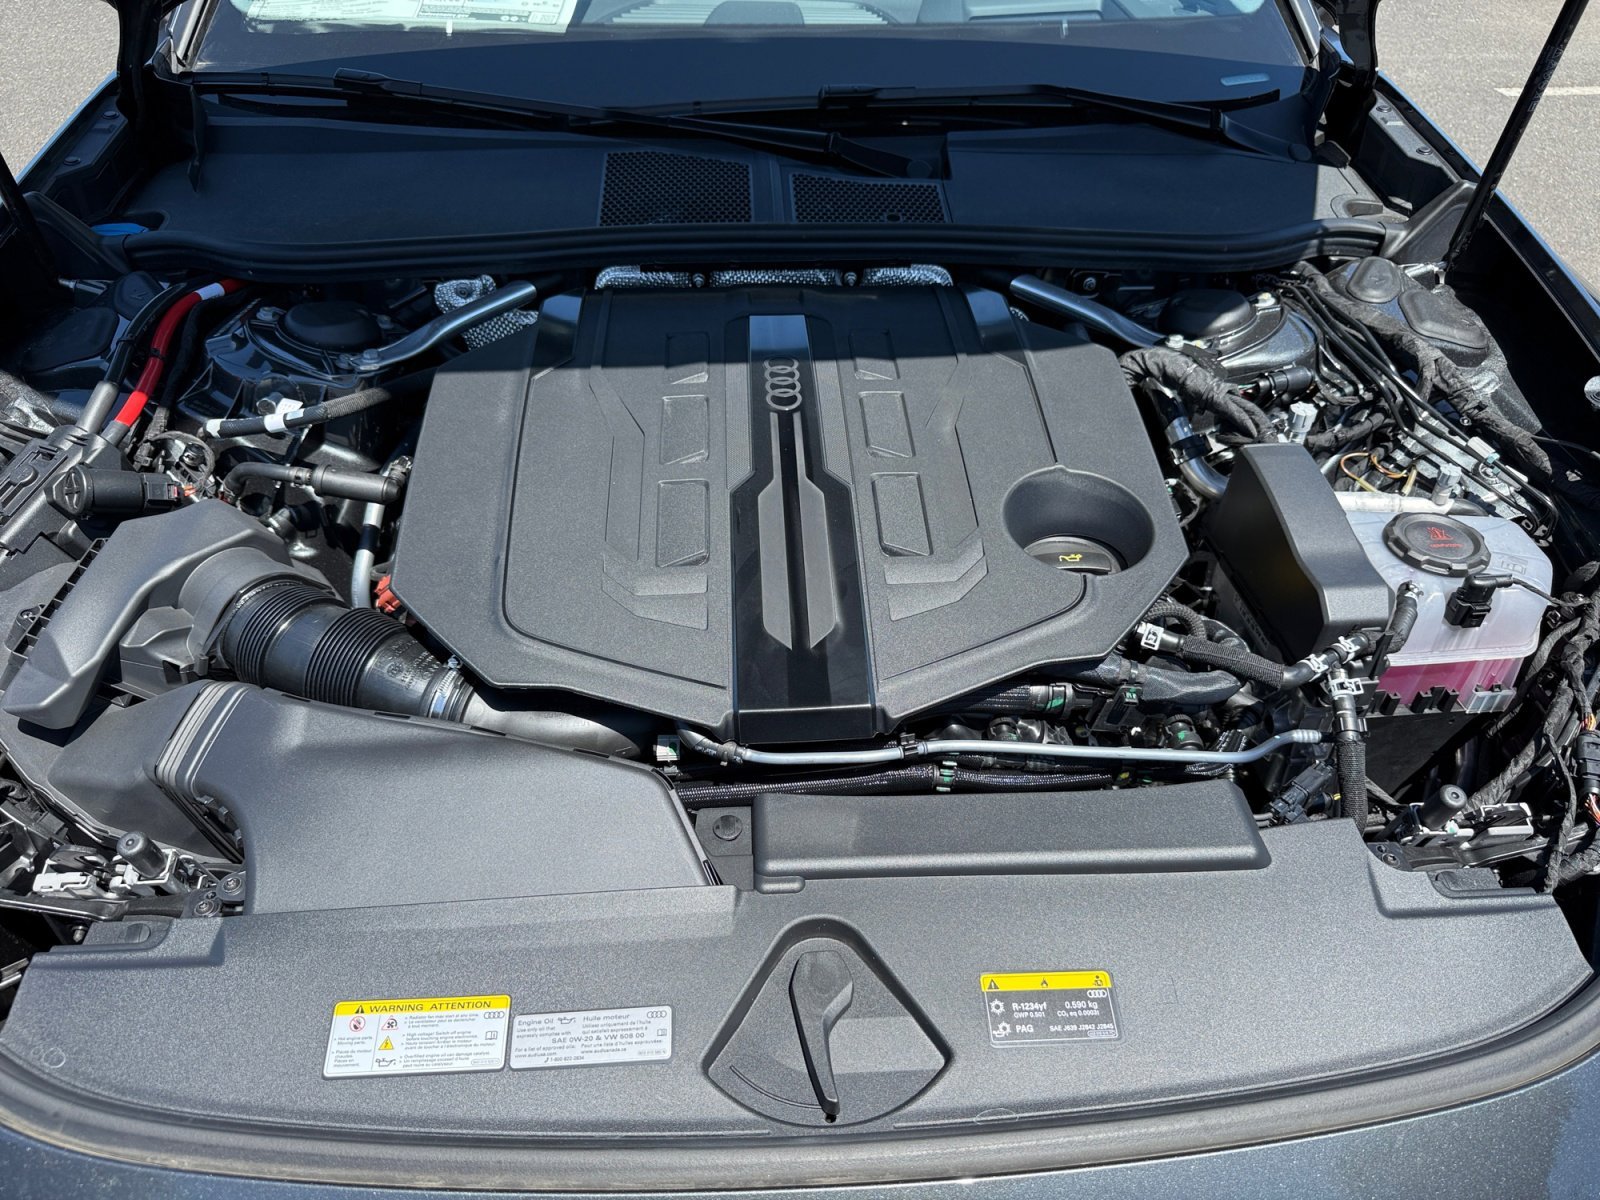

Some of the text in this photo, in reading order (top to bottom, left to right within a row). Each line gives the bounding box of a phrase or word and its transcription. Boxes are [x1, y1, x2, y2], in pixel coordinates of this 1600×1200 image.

[370, 1000, 492, 1012] WARNING ATTENTION
[1012, 1002, 1047, 1011] R-1234yf
[1088, 1000, 1098, 1009] kg
[1016, 1024, 1034, 1033] PAG
